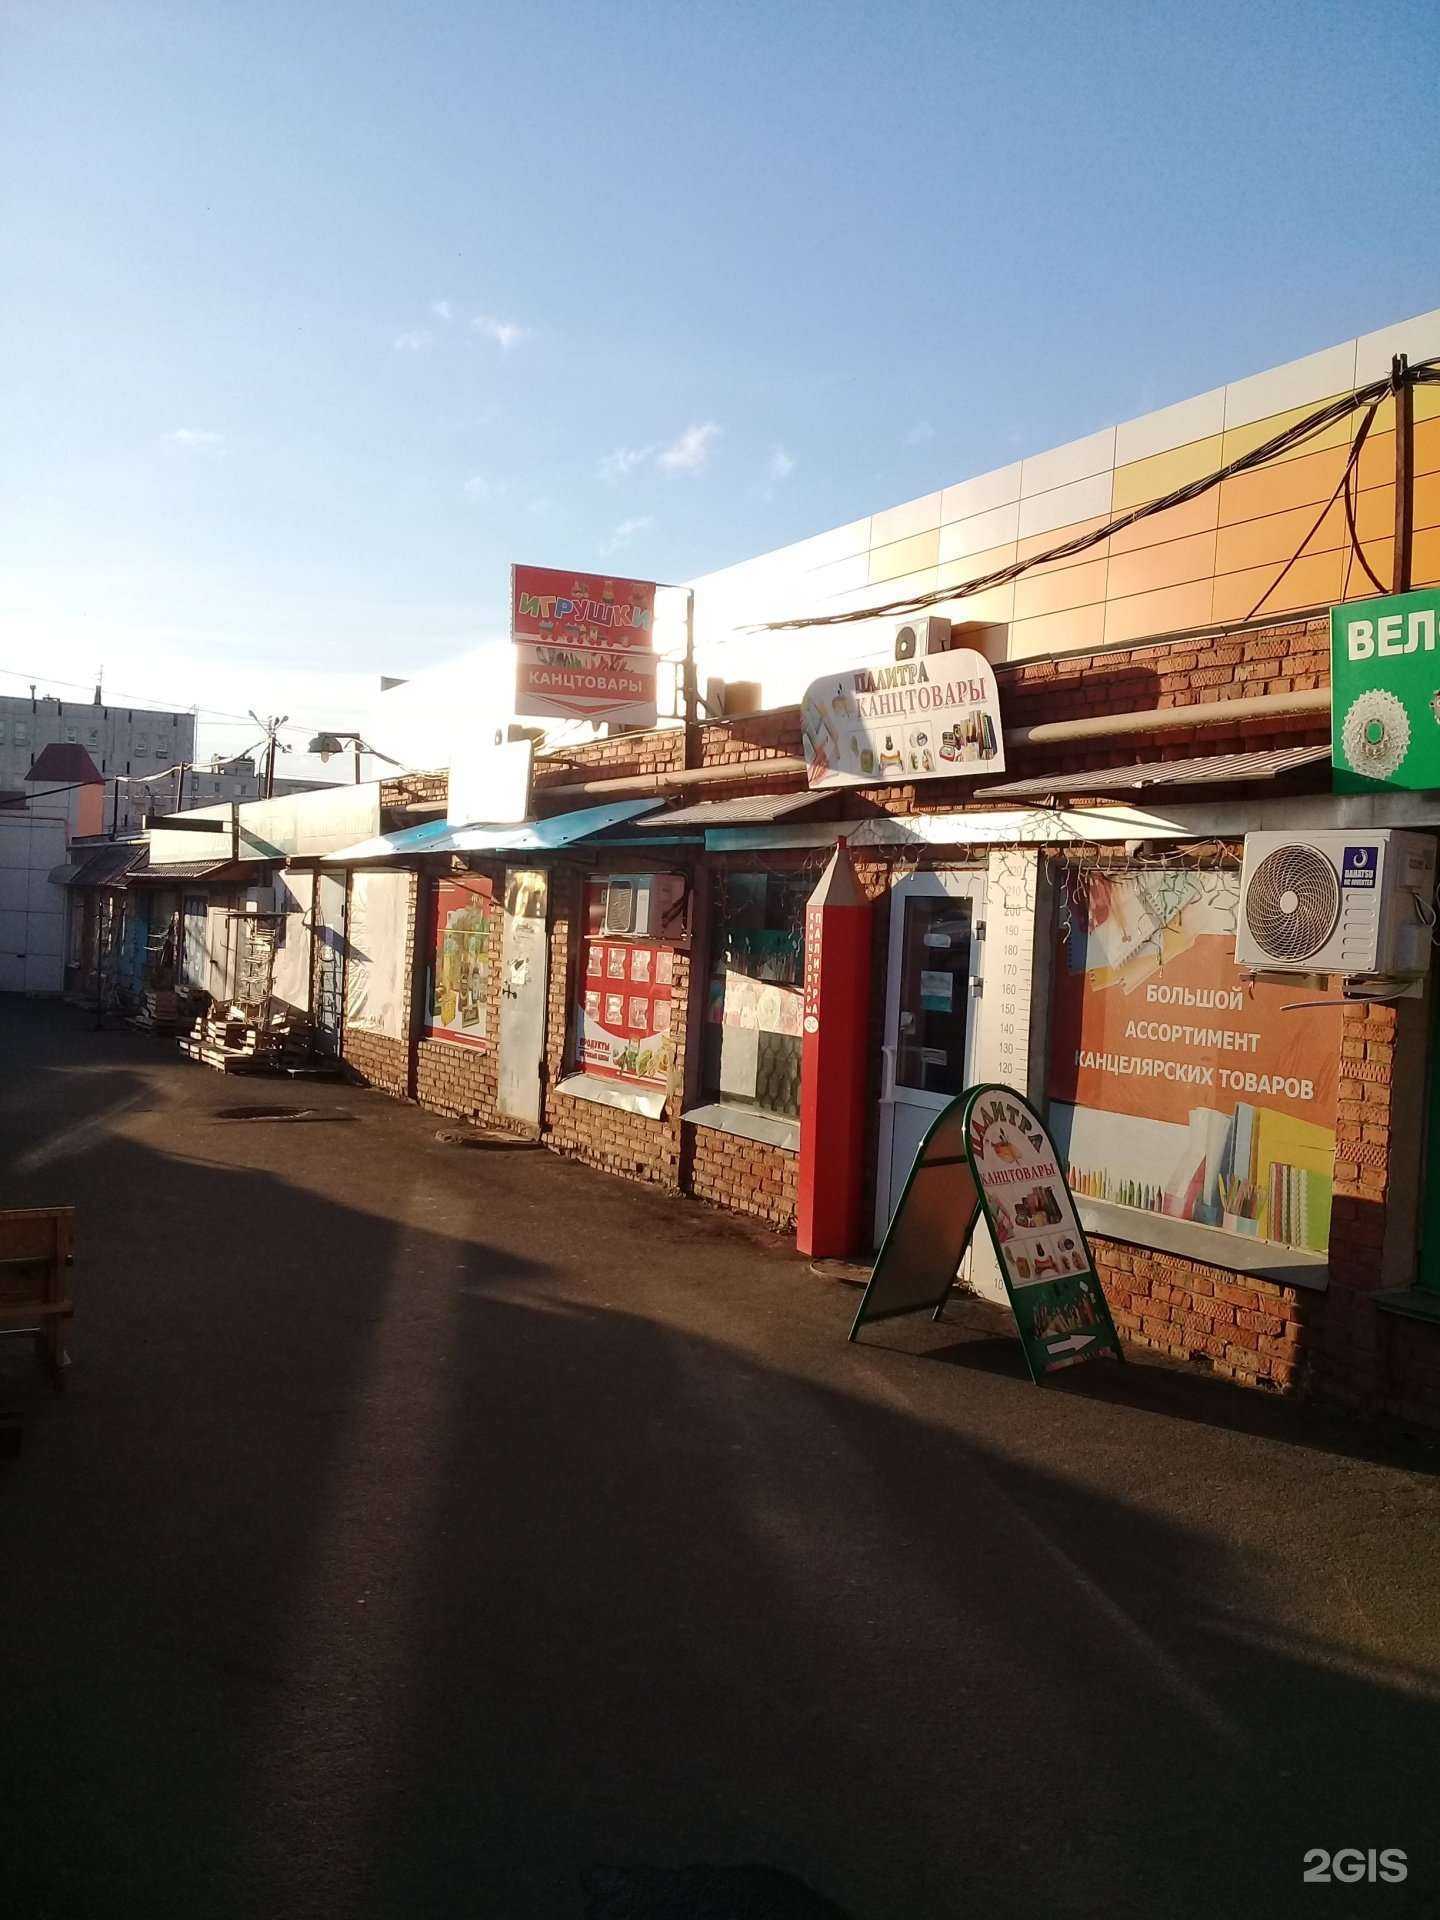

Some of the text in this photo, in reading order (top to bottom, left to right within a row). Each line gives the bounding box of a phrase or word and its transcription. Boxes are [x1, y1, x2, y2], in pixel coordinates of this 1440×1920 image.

[519, 592, 649, 631] ИГРУШКИ
[1348, 610, 1440, 661] ВЕЛ
[528, 670, 642, 693] КАНЦТОВАРЫ
[854, 661, 929, 694] ПАЛИТРА
[857, 677, 986, 719] КАНЦТОВАРЫ
[1005, 925, 1019, 936] 190
[805, 912, 814, 1014] КАНЦТОВАРЫ
[812, 912, 821, 1014] ПАЛИТРА
[1004, 945, 1018, 956] 180
[1004, 965, 1017, 976] 170
[1002, 984, 1016, 995] 160
[1146, 984, 1243, 1011] БОЛЬШОЙ
[1001, 1003, 1015, 1014] 150
[1000, 1023, 1014, 1034] 140
[1125, 1020, 1261, 1052] АССОРТИМЕНТ
[999, 1043, 1013, 1054] 130
[999, 1062, 1013, 1074] 120
[1075, 1050, 1314, 1100] КАНЦЕЛЯРСКИХ ТОВАРОВ
[971, 1101, 1044, 1161] ПАЛИТРА
[980, 1163, 1056, 1185] КАНЦТОВАРЫ
